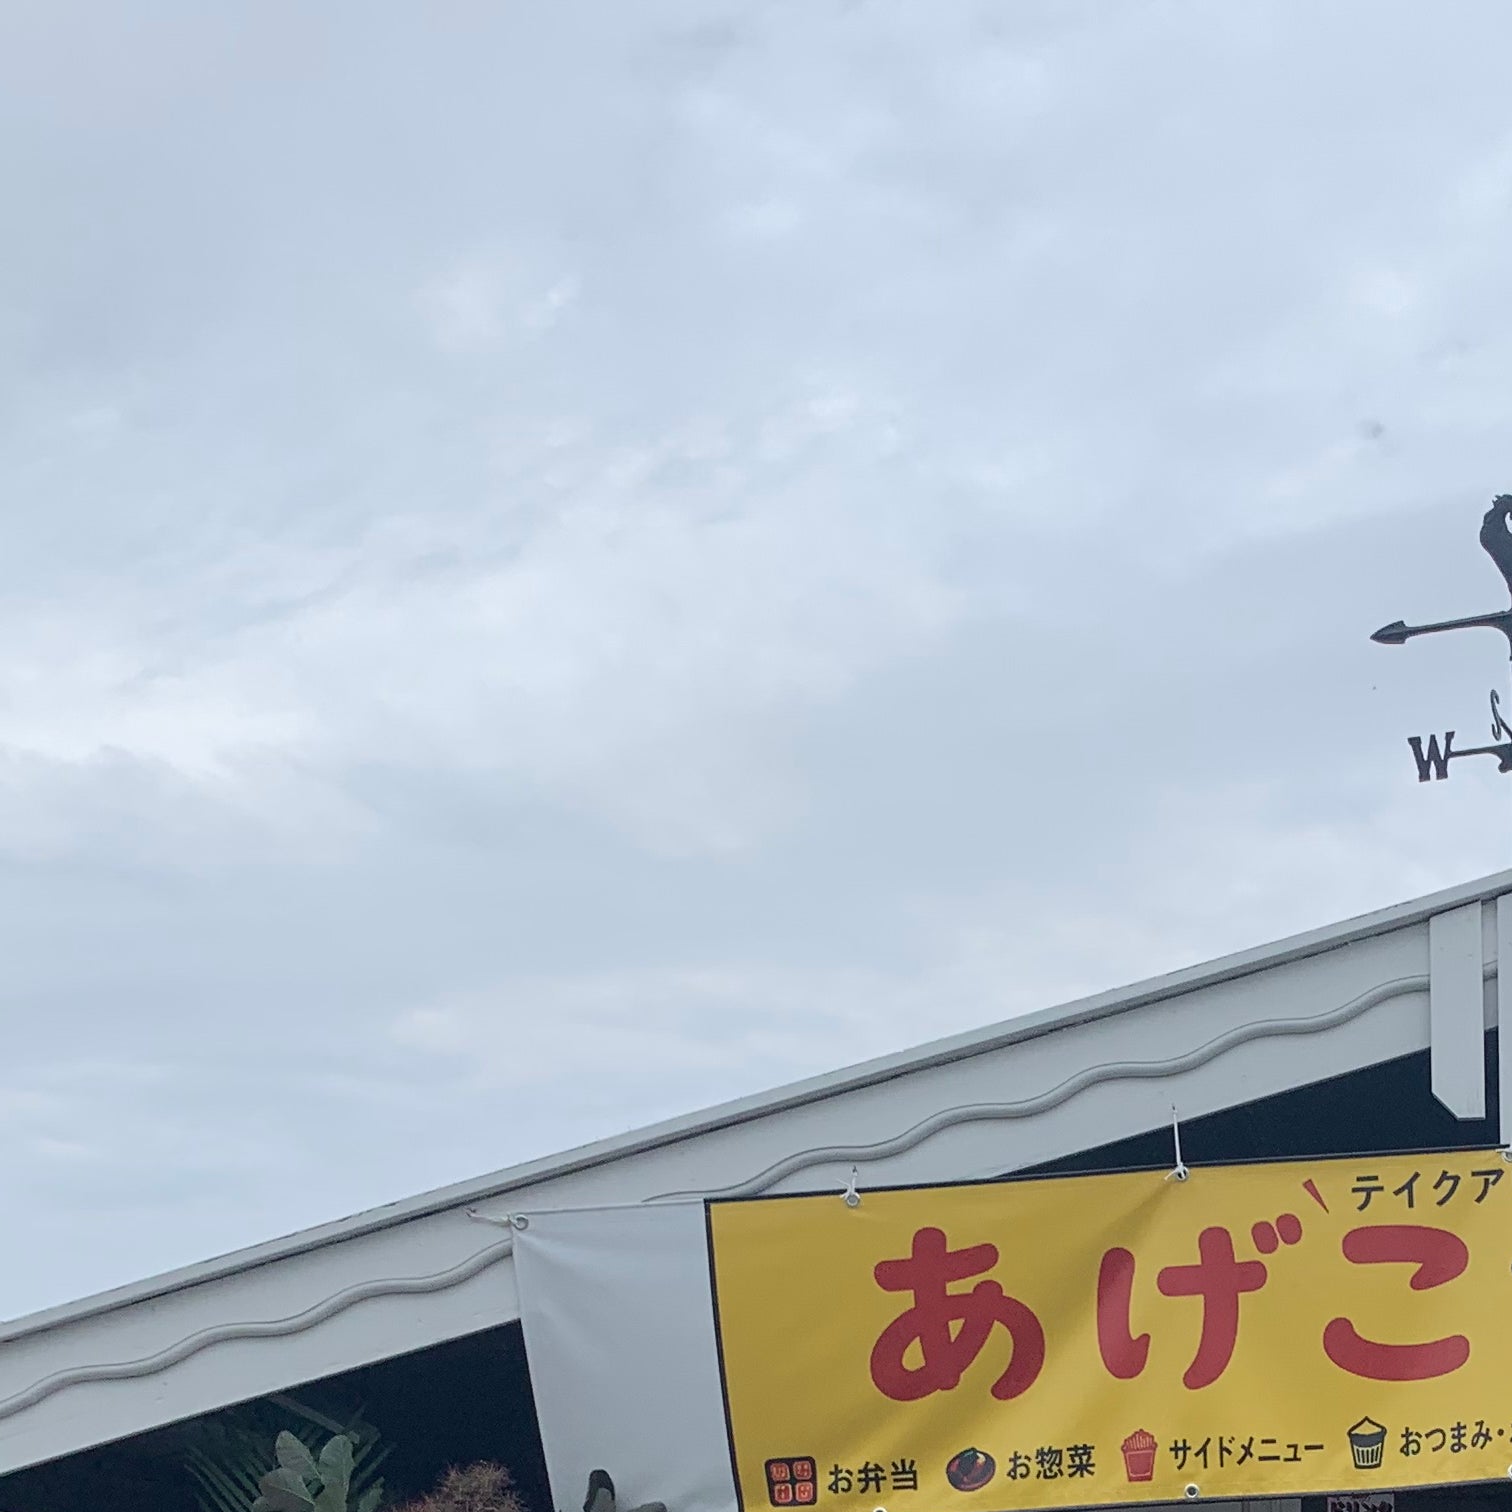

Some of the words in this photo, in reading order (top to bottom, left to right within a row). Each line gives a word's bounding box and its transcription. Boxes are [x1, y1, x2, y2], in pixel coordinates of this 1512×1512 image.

[1407, 731, 1456, 783] W
[1006, 1443, 1098, 1481] お惣菜
[1168, 1435, 1325, 1473] サイドメニュー
[826, 1458, 921, 1496] お弁当
